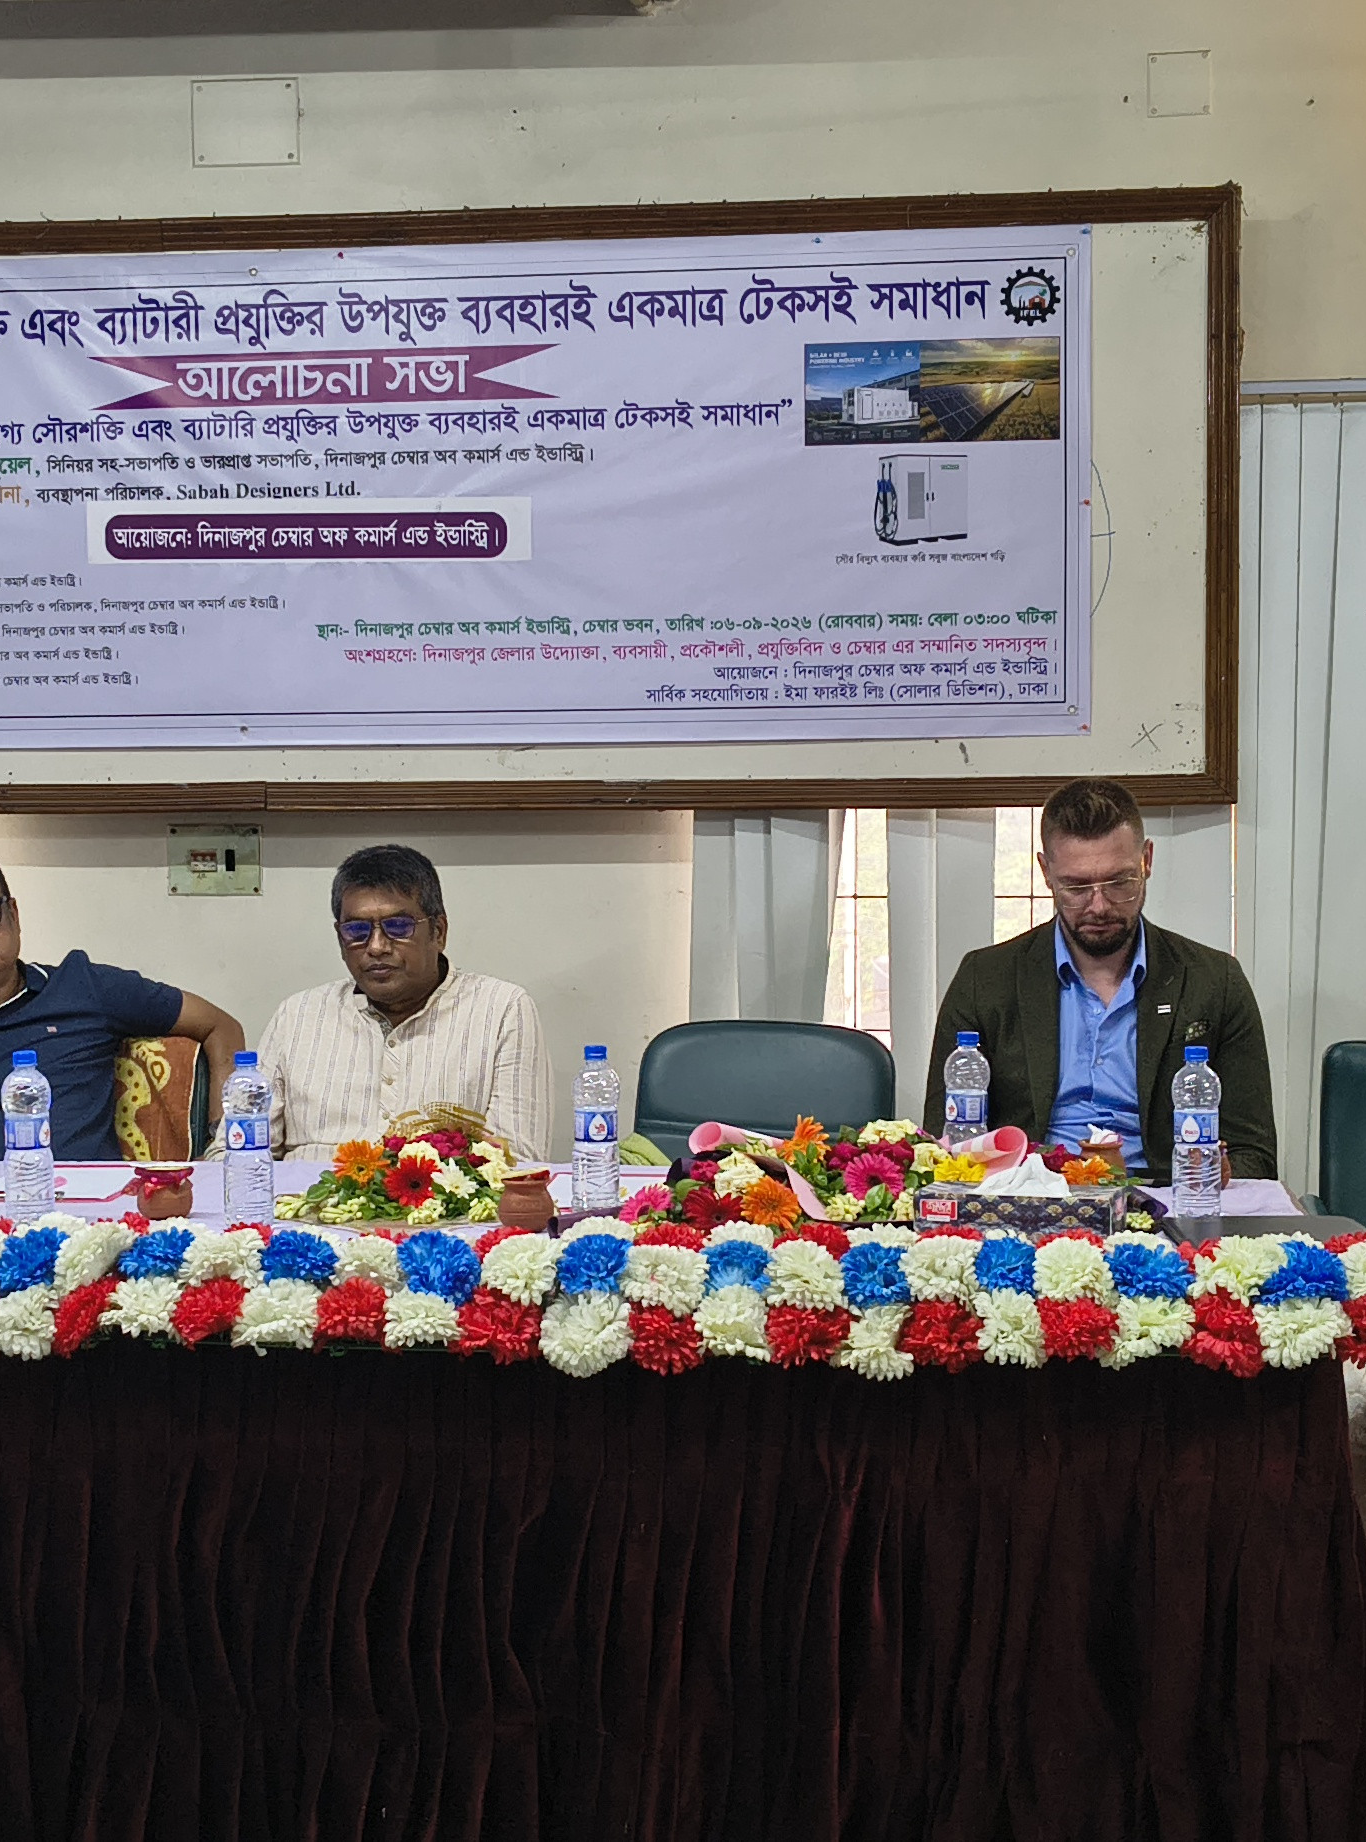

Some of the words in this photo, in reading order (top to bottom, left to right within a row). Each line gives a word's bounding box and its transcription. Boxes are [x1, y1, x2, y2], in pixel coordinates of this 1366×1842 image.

[20, 308, 81, 347] এবং
[93, 289, 205, 346] ব্যাটারী
[214, 288, 328, 350] প্রযুক্তির
[335, 286, 449, 346] উপযুক্ত
[456, 278, 598, 335] ব্যবহারই
[608, 284, 728, 329] একমাত্র
[739, 270, 859, 325] টেকসই
[865, 275, 991, 321] সমাধান
[176, 357, 372, 400] আলোচনা
[383, 354, 469, 393] সভা
[32, 413, 126, 444] সৌরশক্তি
[132, 419, 176, 443] এবং
[181, 409, 257, 441] ব্যাটারি
[262, 408, 340, 444] প্রযুক্তির
[344, 407, 420, 441] উপযুক্ত
[425, 402, 520, 435] ব্যবহারই
[526, 406, 608, 431] একমাত্র
[614, 397, 695, 429] টেকসই
[699, 398, 792, 427] সমাধান”
[45, 454, 94, 474] সিনিয়র
[96, 451, 180, 476] সহ-সভাপতি
[183, 456, 195, 469] ও
[198, 452, 253, 470] ভারপ্রাপ্ত
[323, 447, 387, 470] দিনাজপুর
[391, 449, 430, 466] চেম্বার
[434, 449, 458, 465] অব
[460, 443, 502, 464] কমার্স
[505, 447, 531, 463] এন্ড
[35, 486, 100, 503] ব্যবস্থাপনা
[176, 483, 229, 500] Sabah
[235, 481, 319, 500] Designers
[324, 480, 361, 498] Ltd.
[196, 520, 267, 553] দিনাজপুর
[271, 526, 314, 548] চেম্বার
[317, 527, 349, 547] অফ
[352, 519, 398, 547] কমার্স
[401, 526, 430, 547] এন্ড
[713, 665, 778, 681] আয়োজনে
[792, 660, 854, 681] দিনাজপুর
[858, 663, 895, 677] চেম্বার
[899, 663, 925, 676] অফ
[929, 657, 969, 676] কমার্স
[972, 661, 997, 675] এন্ড
